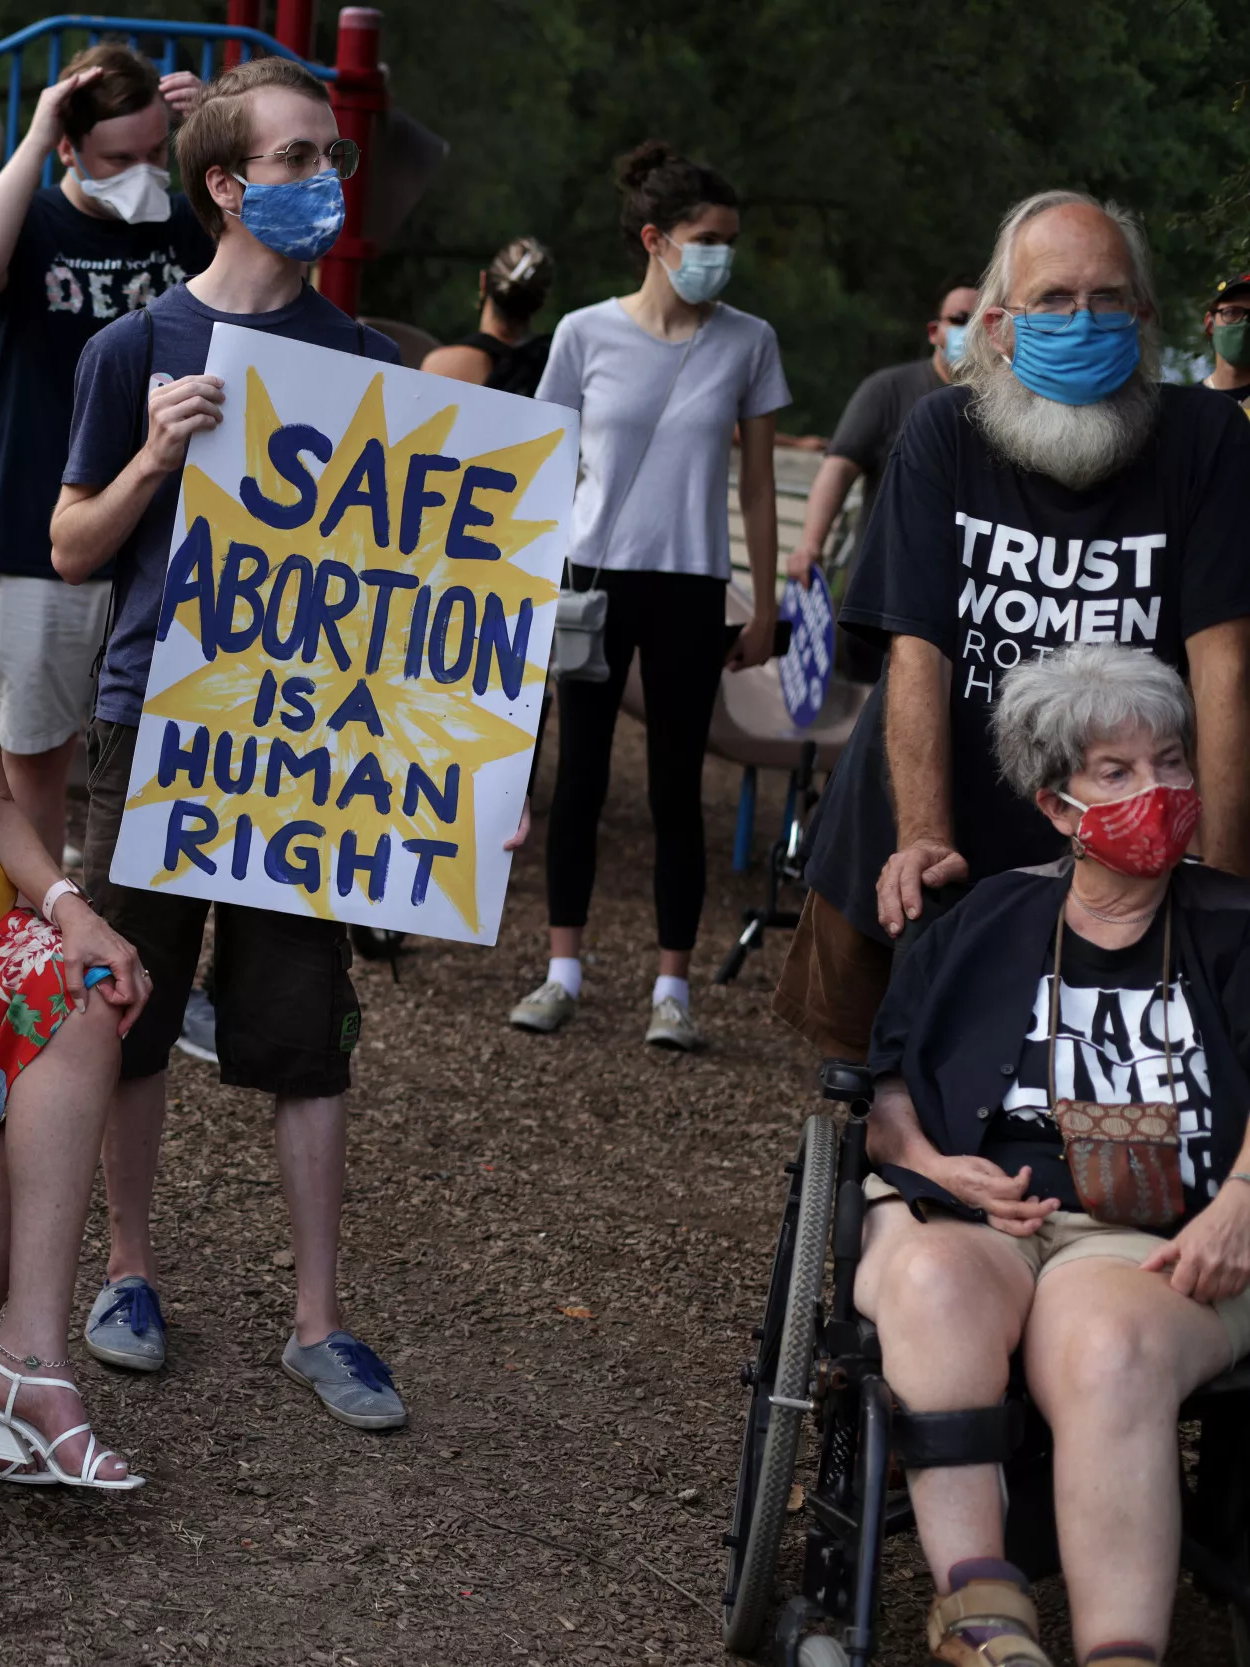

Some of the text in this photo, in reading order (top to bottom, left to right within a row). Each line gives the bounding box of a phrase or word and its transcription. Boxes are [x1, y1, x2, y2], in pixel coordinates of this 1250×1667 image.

[239, 423, 518, 560] SAFE
[955, 511, 1167, 592] TRUST
[157, 515, 534, 701] ABORTION
[958, 577, 1162, 643] WOMEN
[252, 669, 384, 737] IS A
[157, 720, 461, 824] HUMAN
[162, 799, 460, 907] RIGHT
[1028, 974, 1202, 1062] LAC
